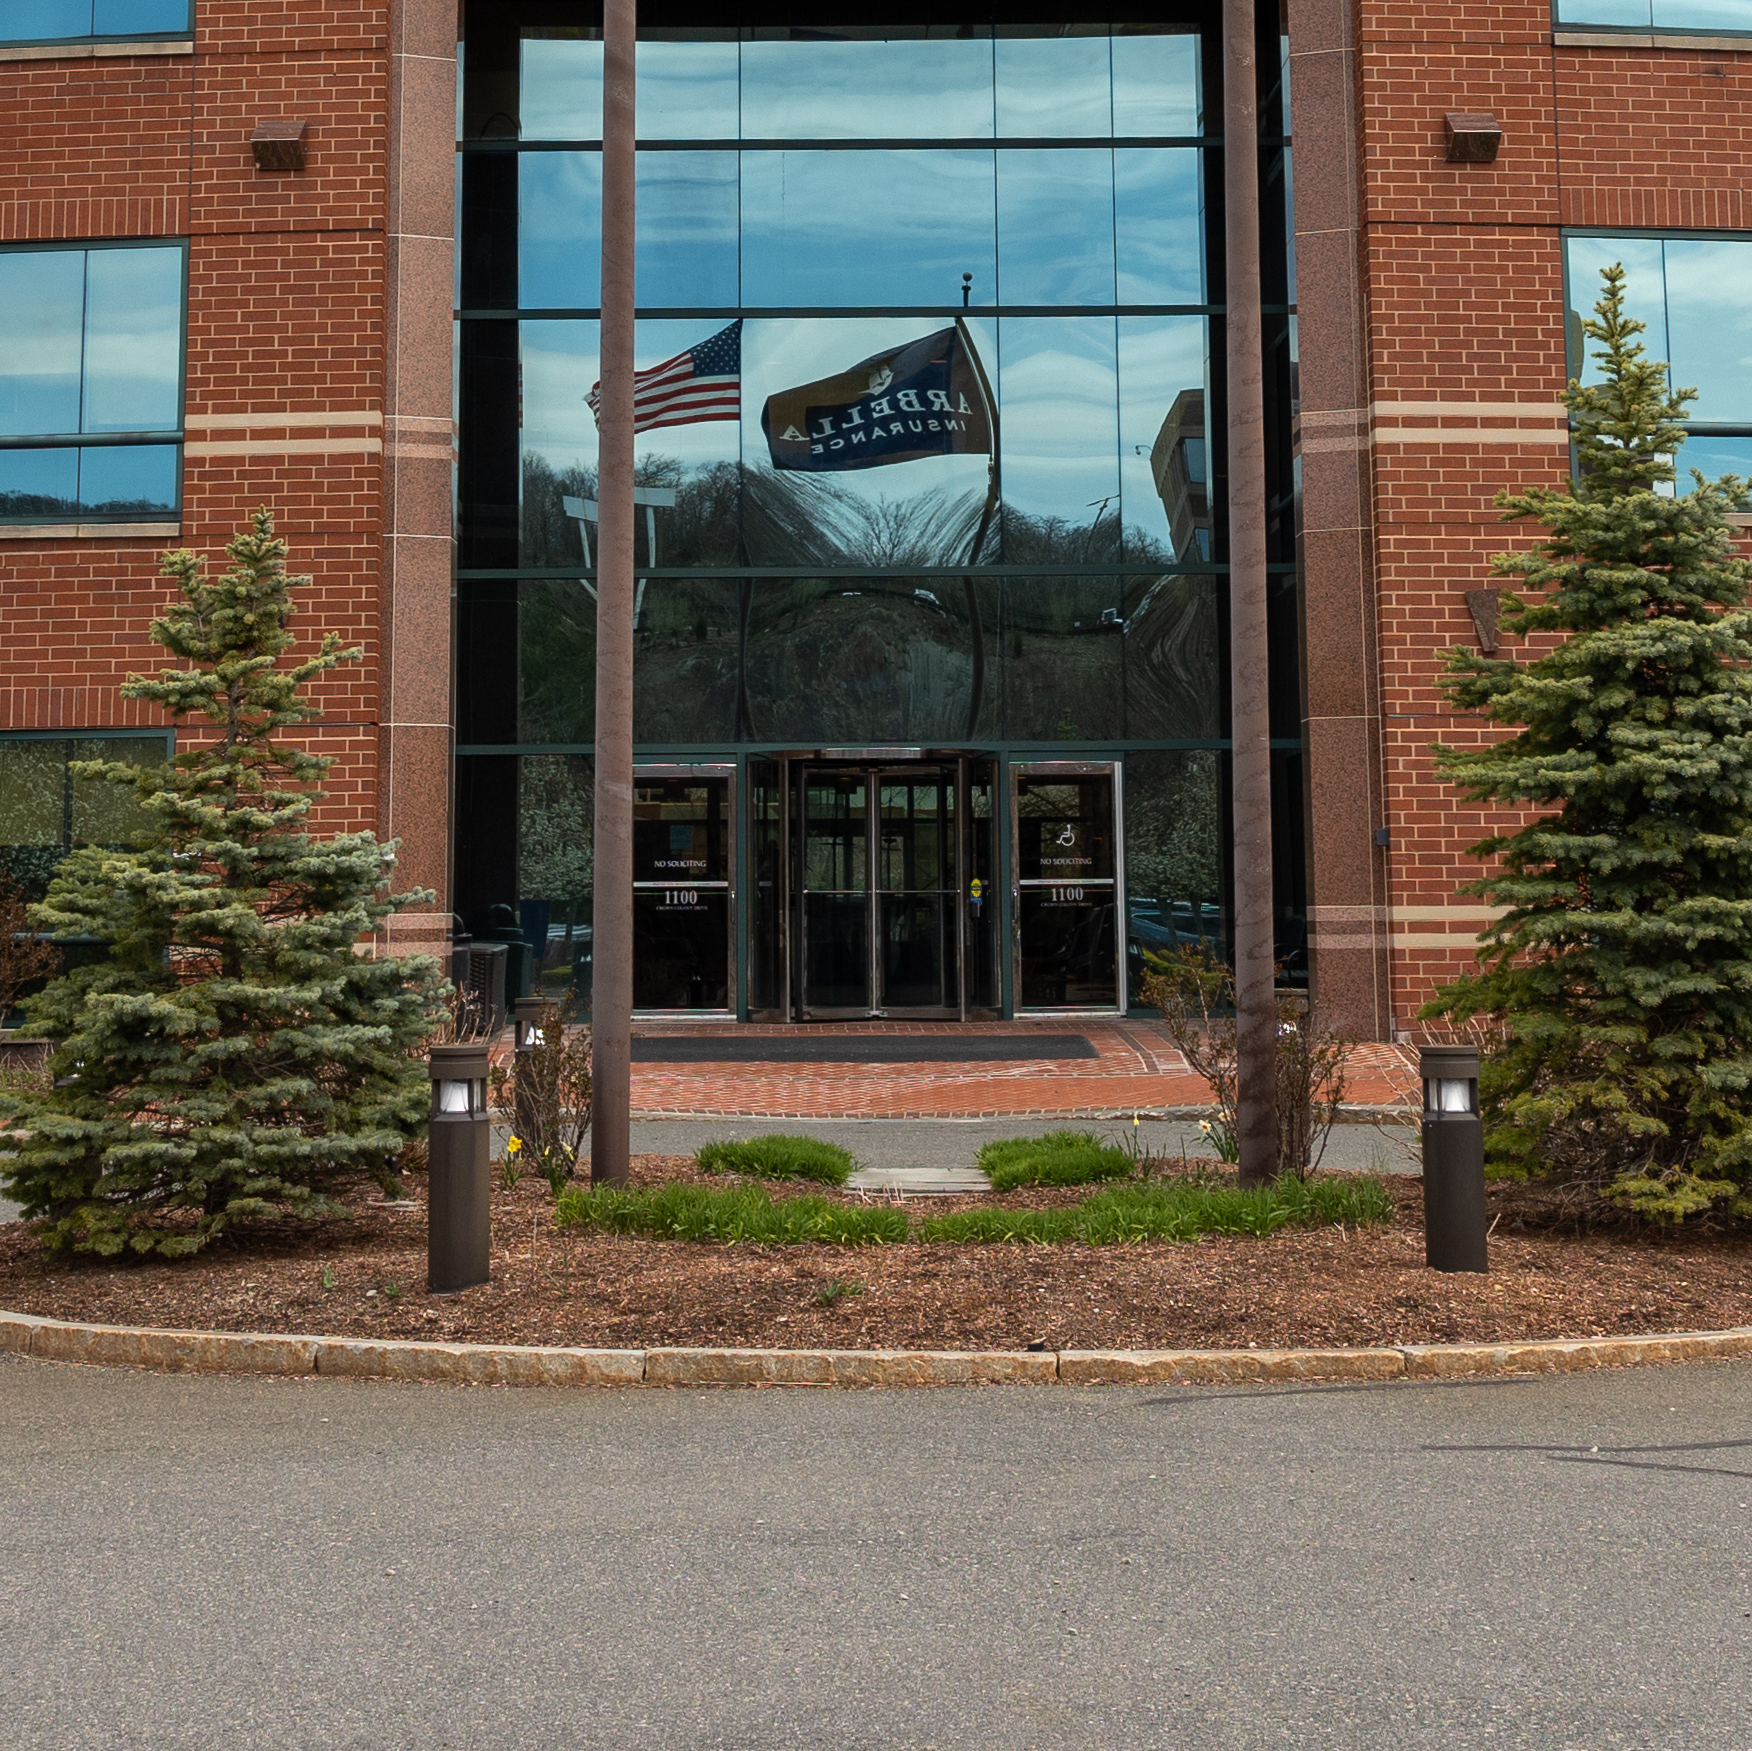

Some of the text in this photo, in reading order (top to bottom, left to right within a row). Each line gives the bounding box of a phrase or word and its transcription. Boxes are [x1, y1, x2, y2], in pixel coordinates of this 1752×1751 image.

[654, 860, 707, 868] NO SOLICITING
[665, 890, 698, 905] 1100
[1051, 887, 1084, 902] 1100
